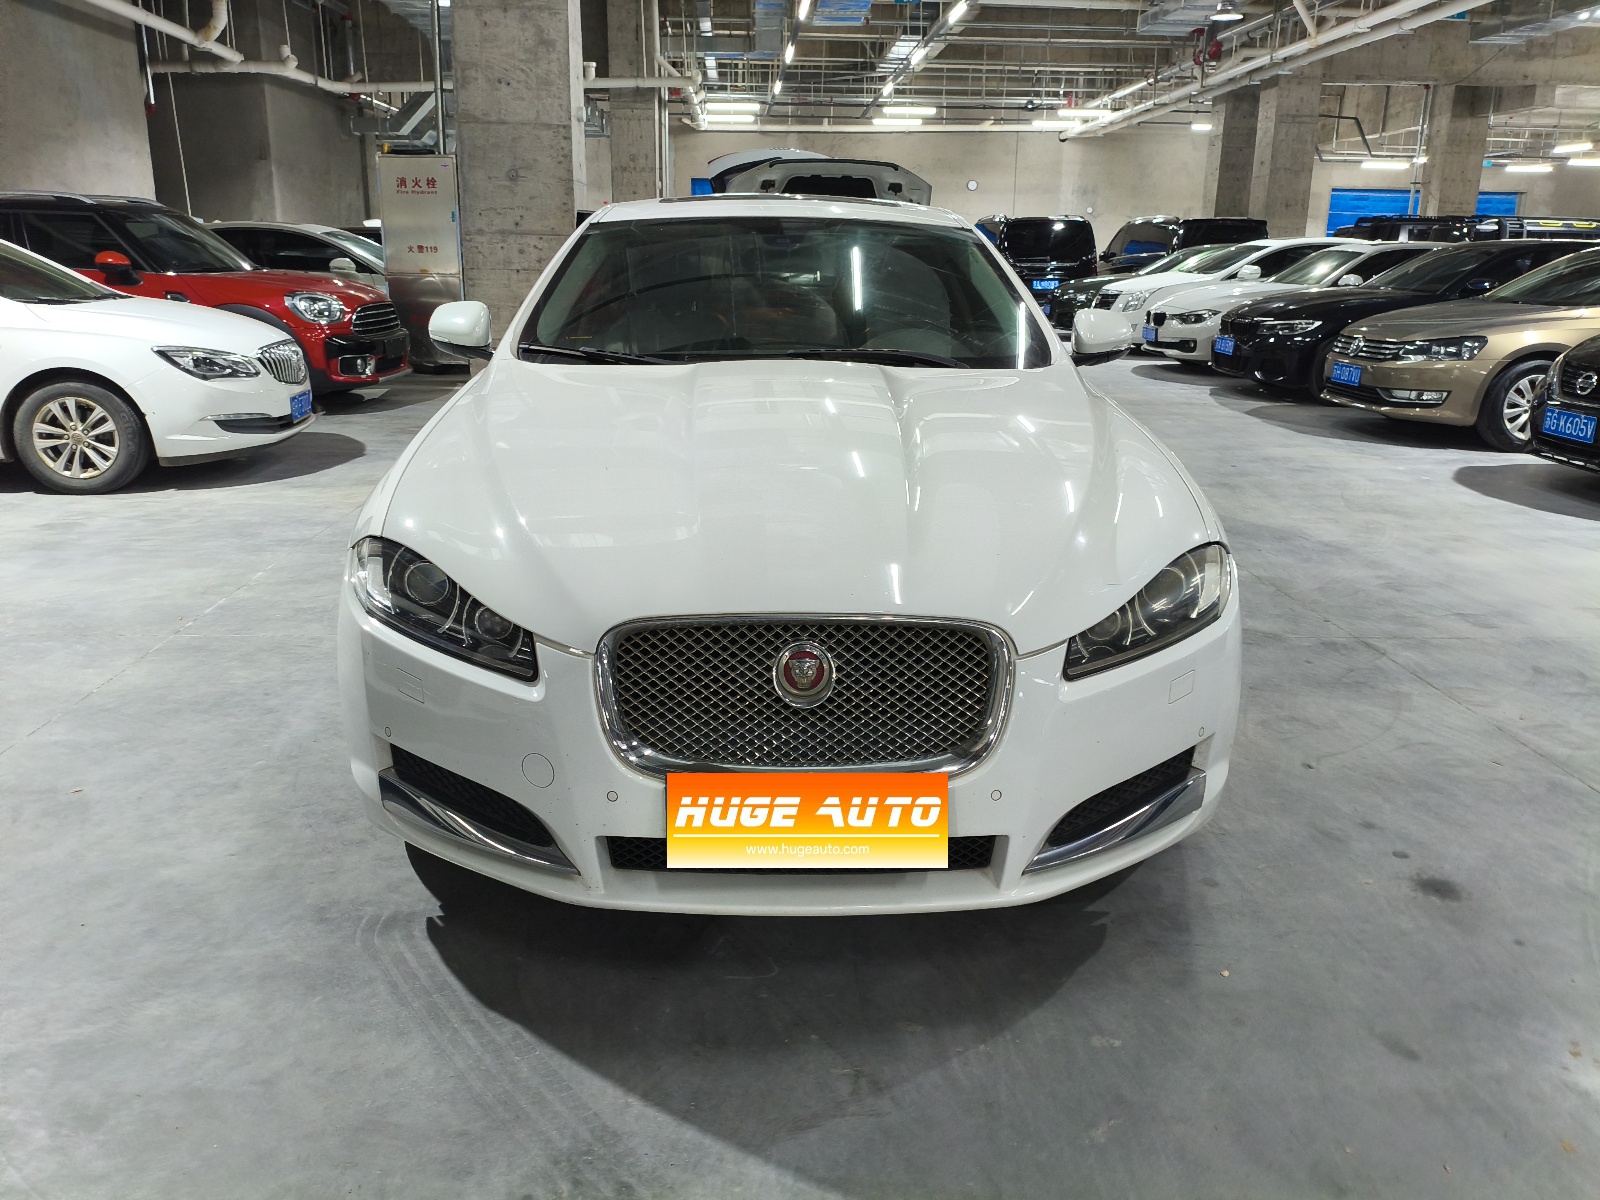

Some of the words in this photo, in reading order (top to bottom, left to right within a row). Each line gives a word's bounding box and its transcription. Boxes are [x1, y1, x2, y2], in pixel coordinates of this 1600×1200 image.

[396, 177, 437, 188] 消火栓
[407, 245, 438, 253] 火警119
